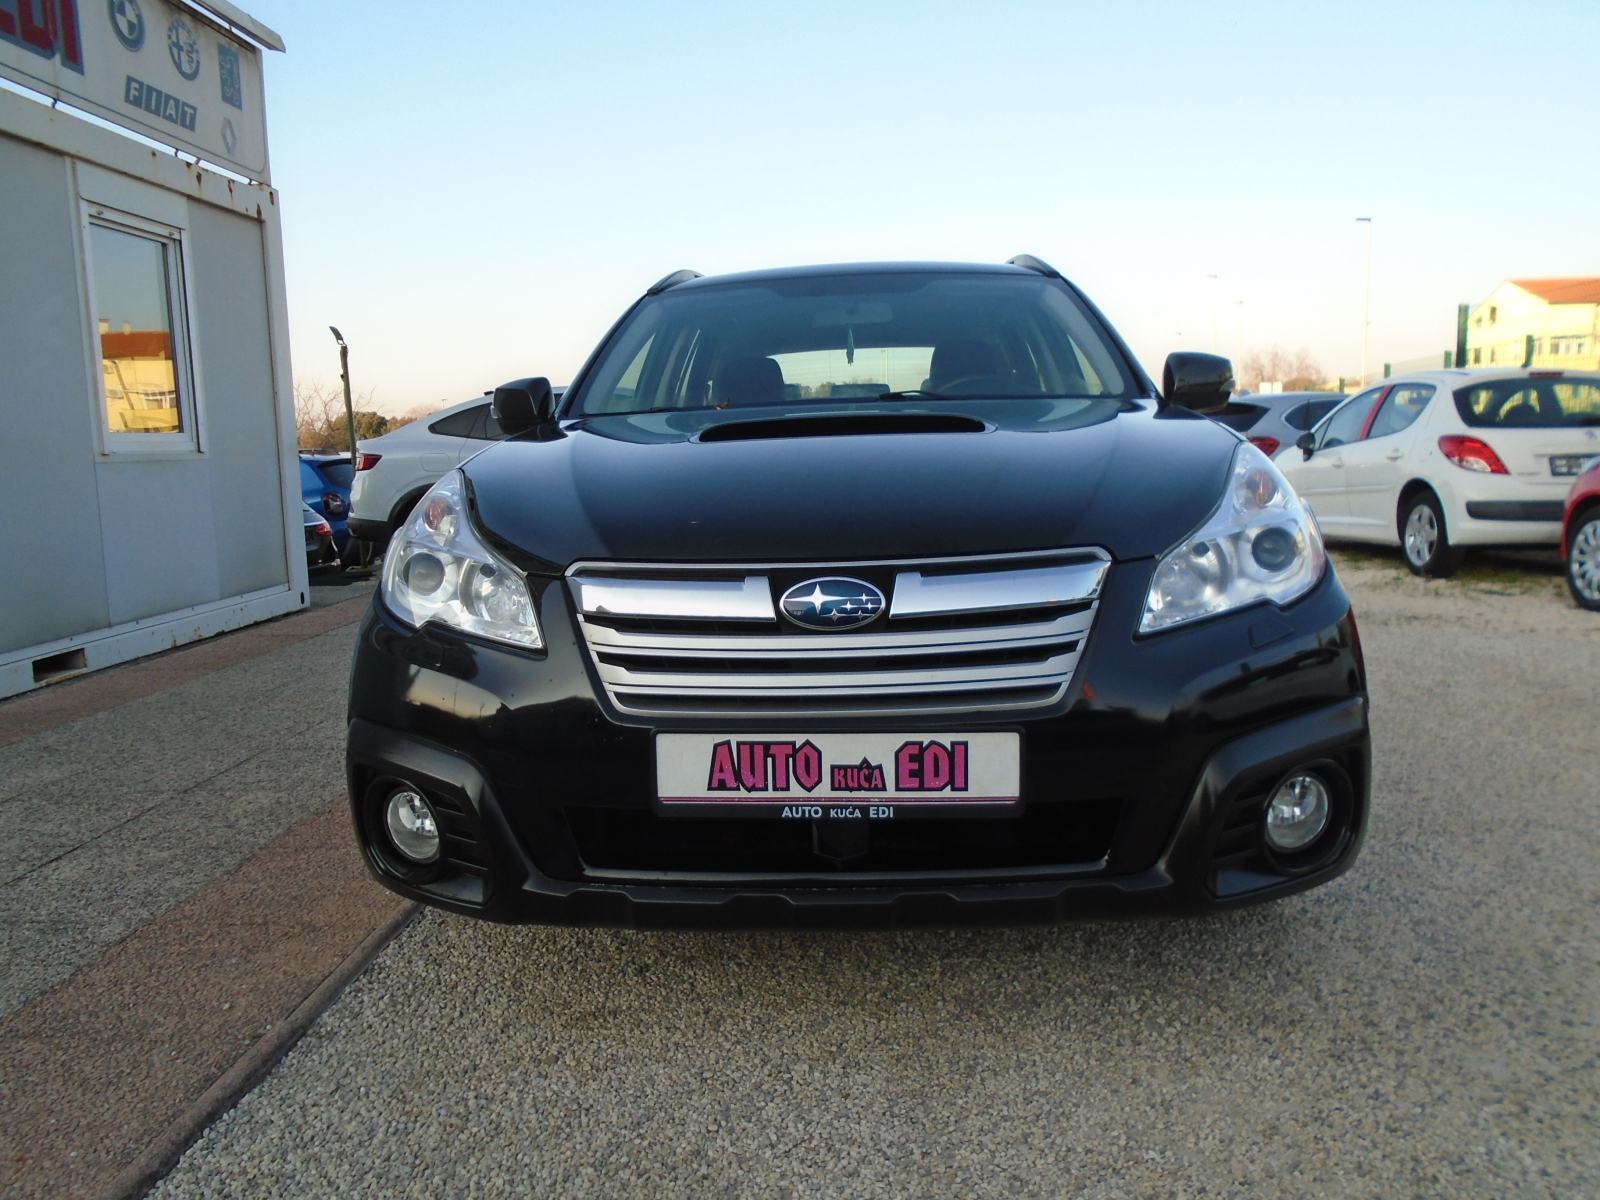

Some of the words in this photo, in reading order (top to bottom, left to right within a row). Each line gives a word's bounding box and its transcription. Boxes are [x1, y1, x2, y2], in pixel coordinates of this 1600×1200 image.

[127, 79, 196, 128] FIAT
[708, 740, 822, 792] AUTO
[896, 740, 968, 791] EDI
[781, 806, 823, 818] AUTO
[830, 806, 862, 818] KUĆA
[869, 806, 894, 818] EDI
